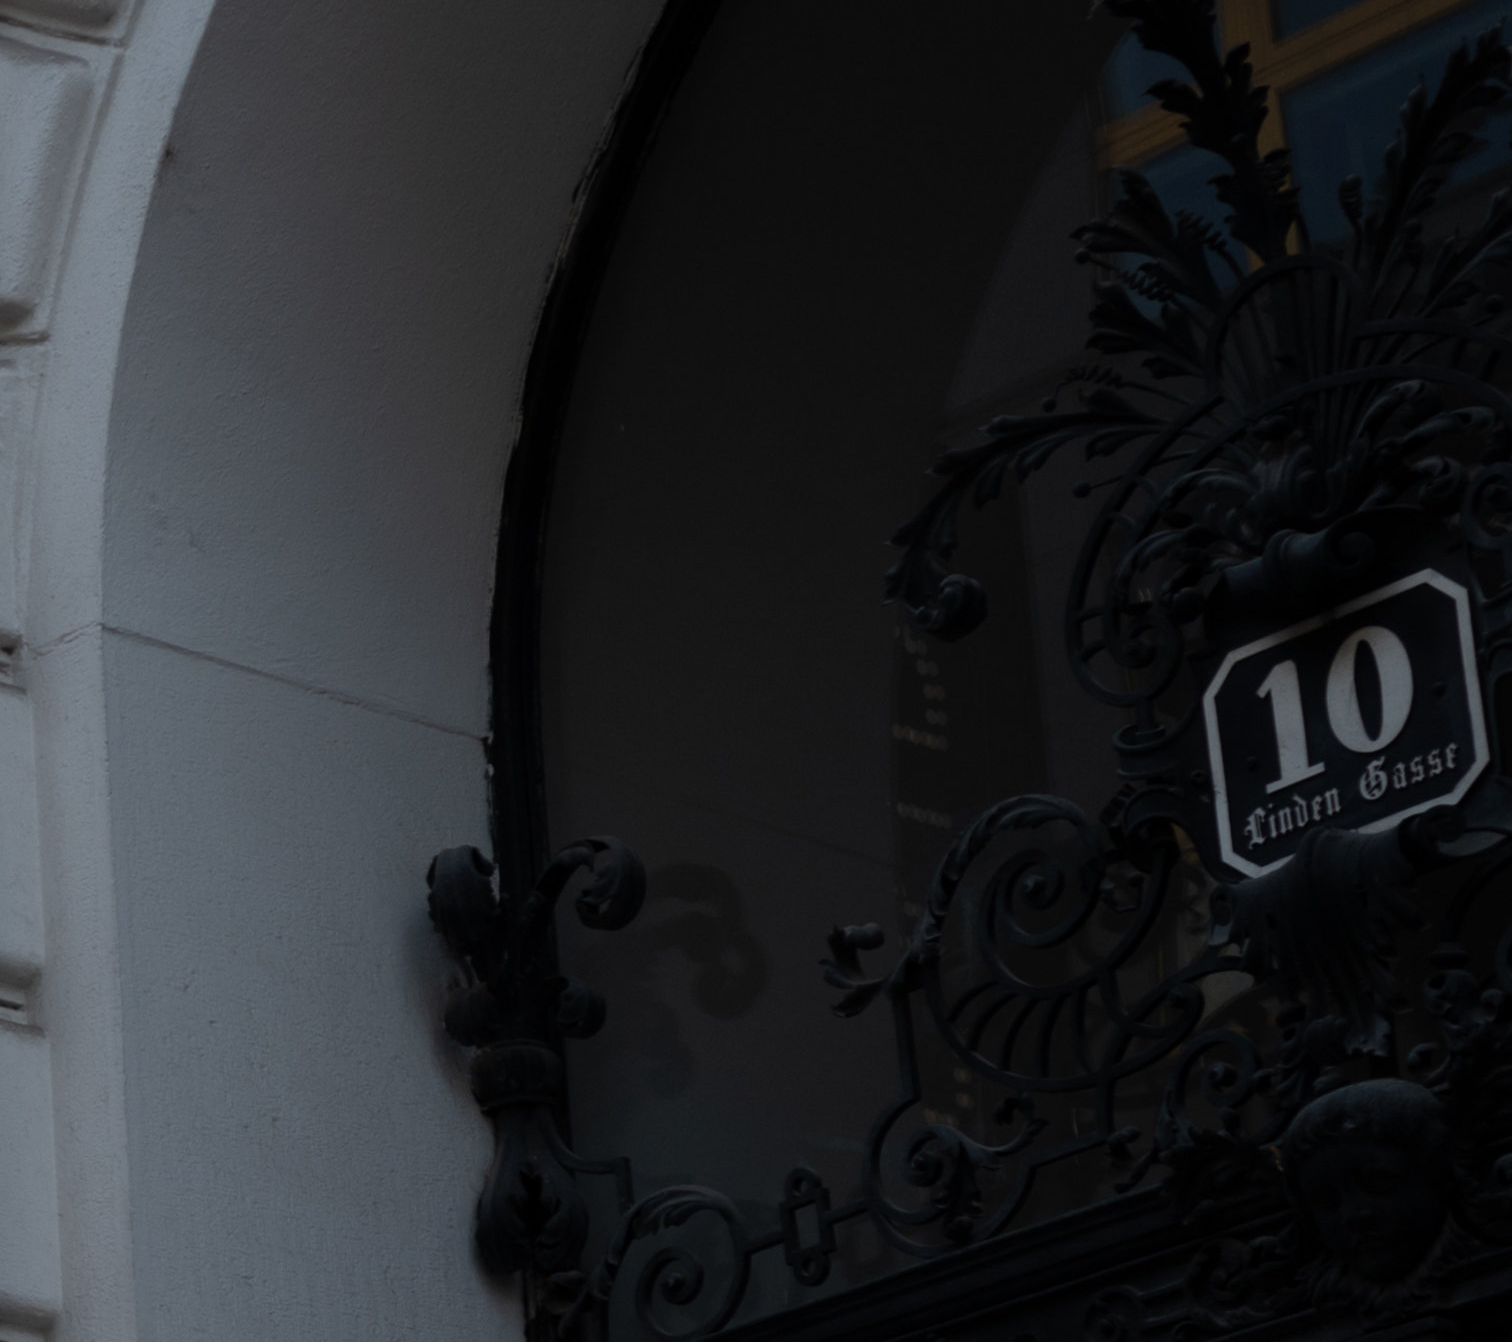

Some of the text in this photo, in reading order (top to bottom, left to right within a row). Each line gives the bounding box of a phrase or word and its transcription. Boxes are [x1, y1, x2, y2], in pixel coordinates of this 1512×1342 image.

[1256, 625, 1414, 795] 10
[1244, 742, 1459, 850] Linden Gasse
